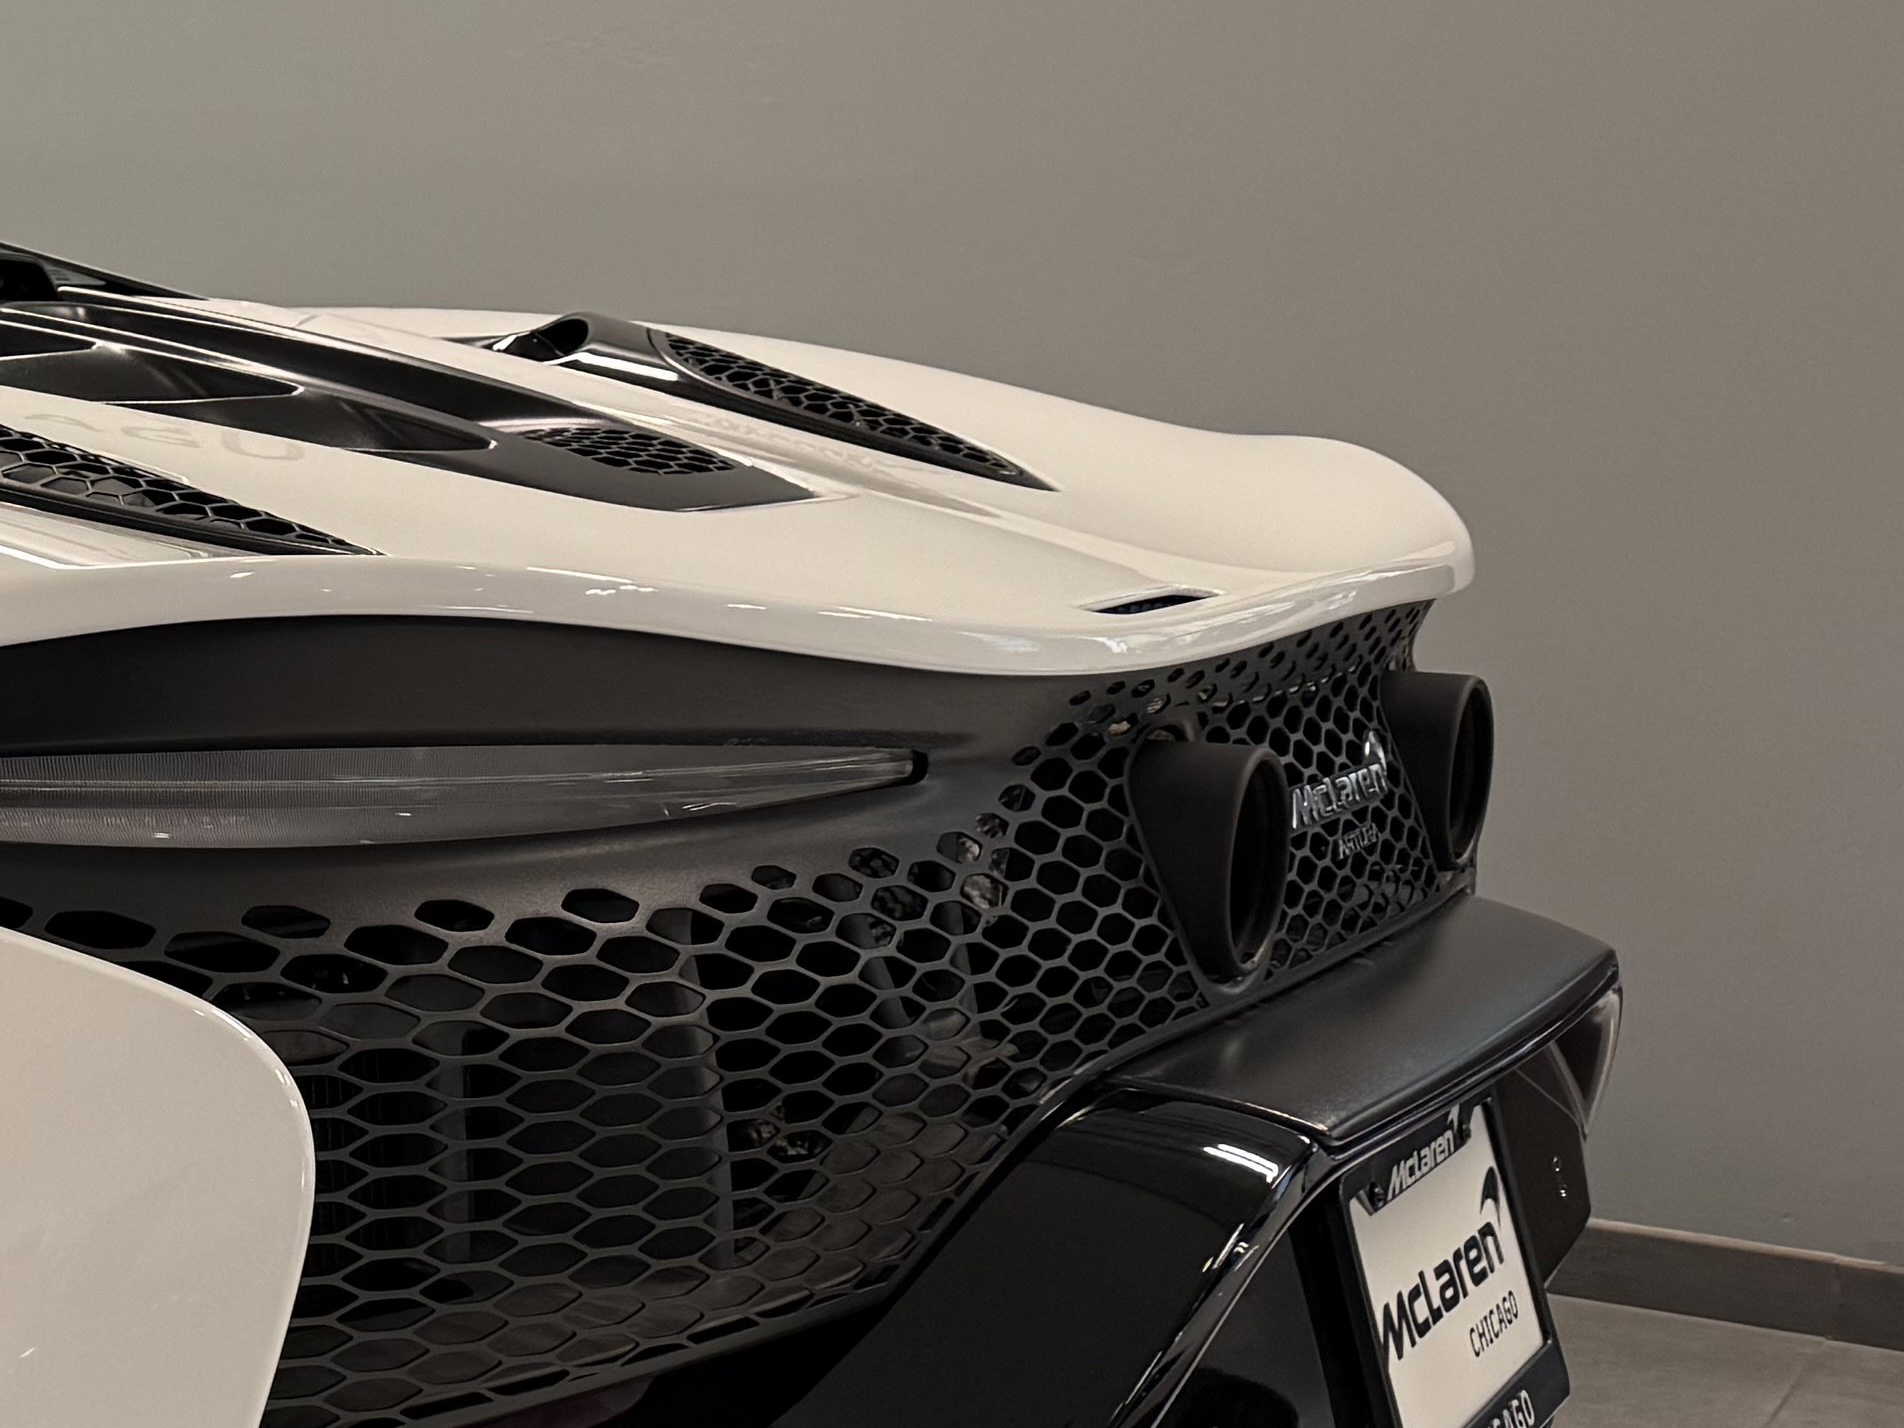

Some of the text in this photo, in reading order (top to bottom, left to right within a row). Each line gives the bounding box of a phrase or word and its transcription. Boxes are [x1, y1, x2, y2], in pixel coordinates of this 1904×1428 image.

[1292, 763, 1388, 829] McLaren
[1387, 1128, 1455, 1202] McLaren
[1381, 1221, 1504, 1371] McLaren
[1469, 1289, 1519, 1359] CHICAGO
